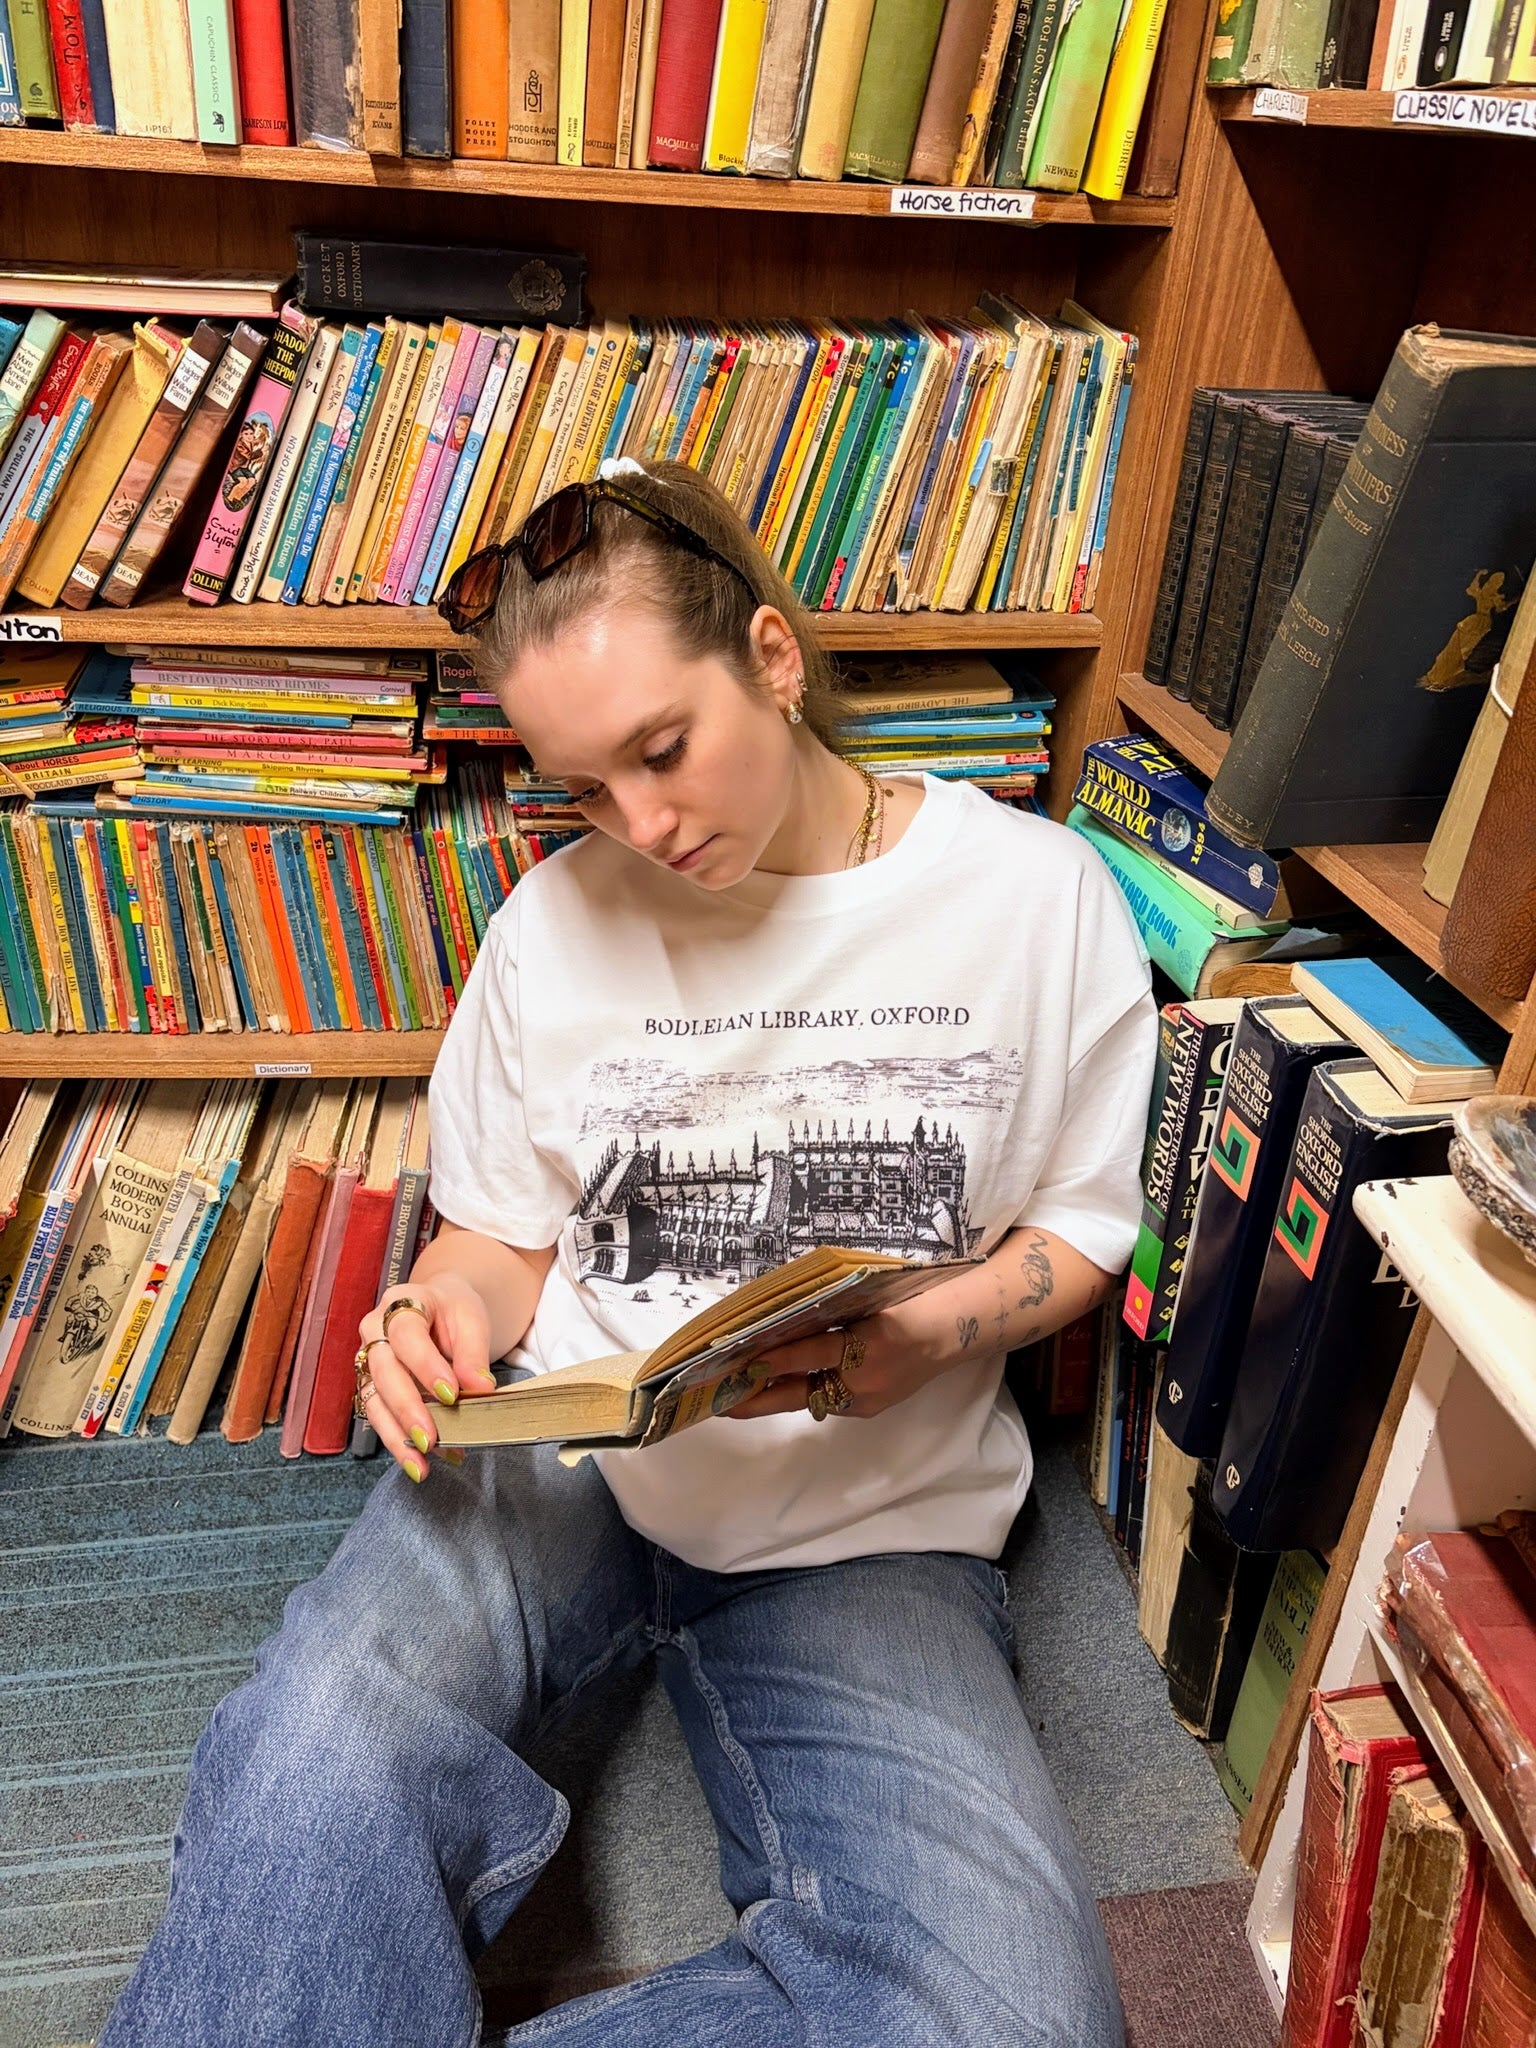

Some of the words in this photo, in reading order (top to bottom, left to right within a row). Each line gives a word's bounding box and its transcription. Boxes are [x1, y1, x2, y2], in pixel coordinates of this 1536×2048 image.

[1014, 13, 1028, 38] GREY
[64, 15, 81, 65] TOM
[207, 16, 216, 62] CAPUCHIN
[1024, 78, 1039, 121] LADY'S
[1034, 45, 1046, 75] NOT
[1040, 15, 1054, 42] FOR
[211, 65, 220, 103] CLASSICS
[1396, 95, 1465, 120] CLASSIC
[243, 118, 272, 130] SAMPSON
[372, 121, 393, 129] EVANS
[465, 119, 496, 128] FOLEY
[466, 128, 497, 137] HOUSE
[508, 123, 540, 134] HODDER
[541, 126, 558, 135] AND
[466, 138, 497, 146] PRESS
[508, 136, 557, 147] STOUGHTON
[656, 136, 699, 151] MACMILLAN
[718, 154, 744, 165] Blackie
[1044, 164, 1078, 178] NEWNES
[1114, 130, 1134, 190] DEBRETT
[900, 191, 954, 212] Horse
[960, 192, 1022, 214] fiction
[336, 251, 345, 298] OXFORD
[353, 240, 362, 308] DICTIONARY
[16, 351, 34, 368] More
[276, 346, 295, 366] THE
[404, 350, 414, 372] Enid
[599, 354, 613, 372] THE
[620, 346, 636, 380] FICTION
[810, 349, 827, 384] FICTION
[900, 358, 912, 374] 1c
[956, 350, 970, 382] FICTION
[1080, 358, 1090, 378] 9a
[11, 360, 32, 378] About
[88, 362, 102, 386] BOOKS
[180, 364, 202, 381] Children
[220, 360, 244, 379] Children
[594, 372, 608, 389] SEA
[834, 354, 850, 392] Storytime
[4, 378, 22, 391] Jane
[170, 388, 188, 402] Farm
[172, 378, 194, 396] Willow
[212, 384, 230, 401] Farm
[214, 376, 236, 394] Willow
[394, 372, 406, 400] Blyton
[412, 374, 424, 401] Blyton
[24, 427, 36, 444] THE
[574, 400, 598, 451] ADVENTURE
[288, 436, 298, 455] FUN
[302, 438, 328, 486] Mystery
[388, 458, 399, 480] Secret
[272, 464, 288, 496] PLENTY
[321, 461, 339, 498] NAUGHTIEST
[450, 458, 474, 510] Naughtiest
[772, 467, 786, 502] Hannibal
[921, 467, 935, 504] Kidnapped
[380, 480, 391, 504] Seven
[264, 494, 278, 518] HAVE
[288, 490, 310, 531] Hidden
[210, 517, 240, 536] Enid
[258, 516, 271, 538] FIVE
[440, 510, 456, 531] Girl
[872, 502, 888, 538] Playgroup
[993, 493, 1014, 560] ADVENTURE
[1344, 509, 1372, 536] SMITH
[204, 528, 236, 551] Blyton
[278, 534, 295, 568] House
[244, 540, 262, 577] Blyton
[74, 565, 98, 585] DEAN
[116, 563, 142, 583] DEAN
[24, 577, 54, 596] COLLINS
[236, 576, 250, 598] Enid
[1288, 638, 1322, 668] LEECH
[158, 673, 185, 683] BEST
[189, 674, 228, 686] LOVED
[231, 676, 281, 688] NURSERY
[285, 680, 330, 690] RHYMES
[380, 684, 406, 694] Carnival
[78, 704, 122, 713] RELIGIOUS
[126, 706, 156, 714] TOPICS
[866, 704, 892, 714] BOOK
[901, 698, 946, 710] LADYBIRD
[233, 735, 272, 744] STORY
[454, 730, 479, 738] THE
[15, 762, 40, 771] about
[42, 756, 80, 766] HORSES
[227, 750, 292, 762] MARCO
[308, 752, 354, 764] POLO
[912, 751, 952, 759] Handwriting
[24, 768, 72, 780] BRITAIN
[27, 778, 72, 790] WOODLAND
[76, 773, 109, 785] FRIENDS
[1086, 756, 1096, 778] THE
[1095, 760, 1151, 810] WORLD
[162, 775, 192, 784] FICTION
[290, 786, 317, 797] Railway
[320, 790, 348, 798] Children
[282, 808, 324, 818] Instruments
[1076, 780, 1156, 841] ALMANAC
[325, 841, 334, 855] 6a
[366, 836, 380, 873] TALKABOUT
[376, 838, 386, 864] FICTION
[355, 886, 368, 924] TRICKS
[363, 926, 373, 944] AND
[368, 950, 381, 978] MAGIC
[1146, 902, 1182, 950] BOOK
[645, 1010, 754, 1036] BODLEIAN
[870, 1006, 970, 1027] OXFORD
[1168, 1016, 1195, 1096] NEW
[1191, 1030, 1204, 1060] THE
[1250, 1046, 1262, 1064] THE
[259, 1064, 310, 1074] Dictionary
[1238, 1048, 1270, 1086] SHORTER
[1184, 1059, 1198, 1104] OXFORD
[1231, 1056, 1274, 1105] OXFORD
[1228, 1070, 1270, 1121] ENGLISH
[1227, 1090, 1262, 1128] DICTIONARY
[1320, 1115, 1334, 1134] THE
[1166, 1102, 1188, 1190] DICTIONARY
[1308, 1116, 1342, 1158] SHORTER
[1147, 1098, 1178, 1204] WORDS
[1300, 1124, 1343, 1177] OXFORD
[1296, 1139, 1340, 1196] ENGLISH
[178, 1170, 192, 1190] BLUE
[402, 1176, 416, 1202] THE
[1296, 1160, 1332, 1202] DICTIONARY
[110, 1178, 165, 1207] MODERN
[166, 1188, 184, 1214] PETER
[1158, 1190, 1171, 1213] OF
[40, 1205, 58, 1230] BLUE
[58, 1200, 75, 1224] BLUE
[100, 1208, 153, 1234] ANNUAL
[46, 1226, 66, 1256] PETER
[392, 1203, 412, 1260] BROWNIE
[30, 1230, 50, 1260] PETER
[16, 1261, 40, 1299] Sixteenth
[386, 1261, 400, 1288] ANN
[8, 1300, 26, 1320] Book
[20, 1417, 72, 1432] COLLINS
